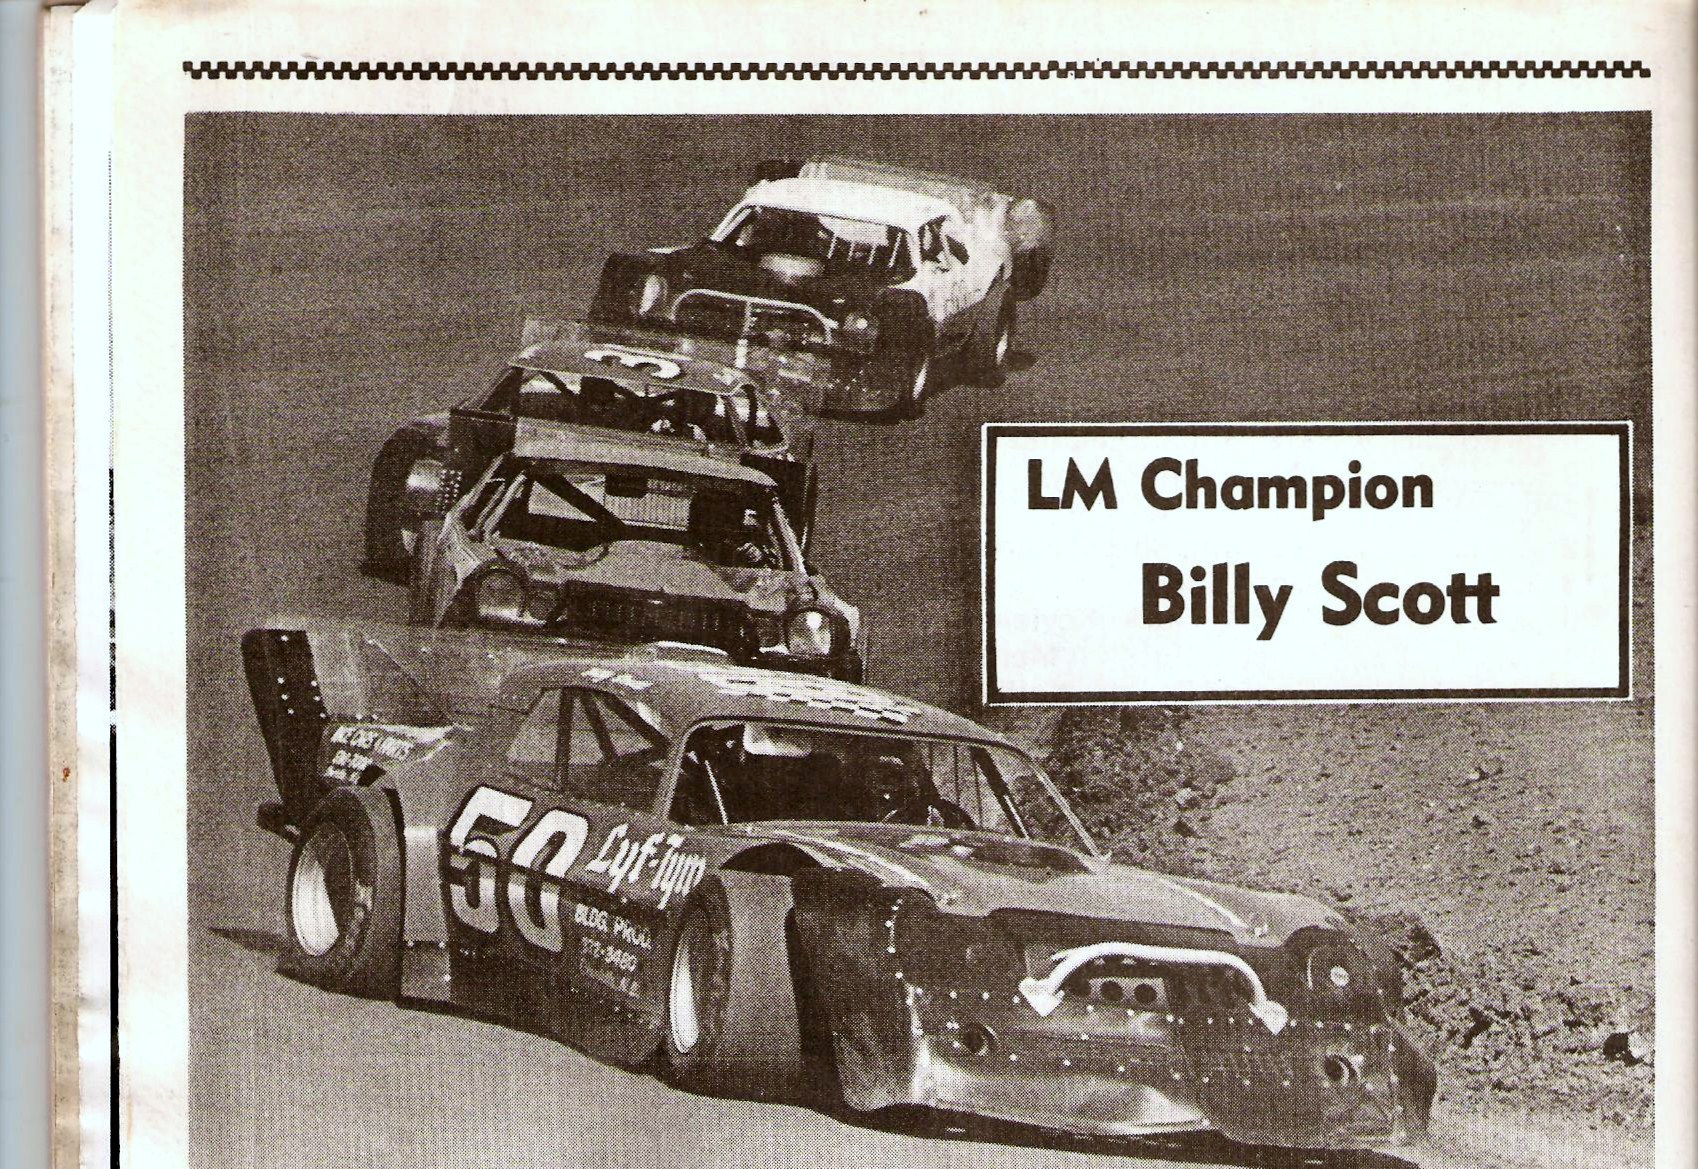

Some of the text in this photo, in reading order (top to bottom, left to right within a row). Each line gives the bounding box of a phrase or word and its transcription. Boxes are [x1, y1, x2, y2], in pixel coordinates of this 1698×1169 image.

[1028, 457, 1433, 521] LM Champion
[1143, 561, 1500, 640] Billy Scott
[450, 786, 589, 952] 50
